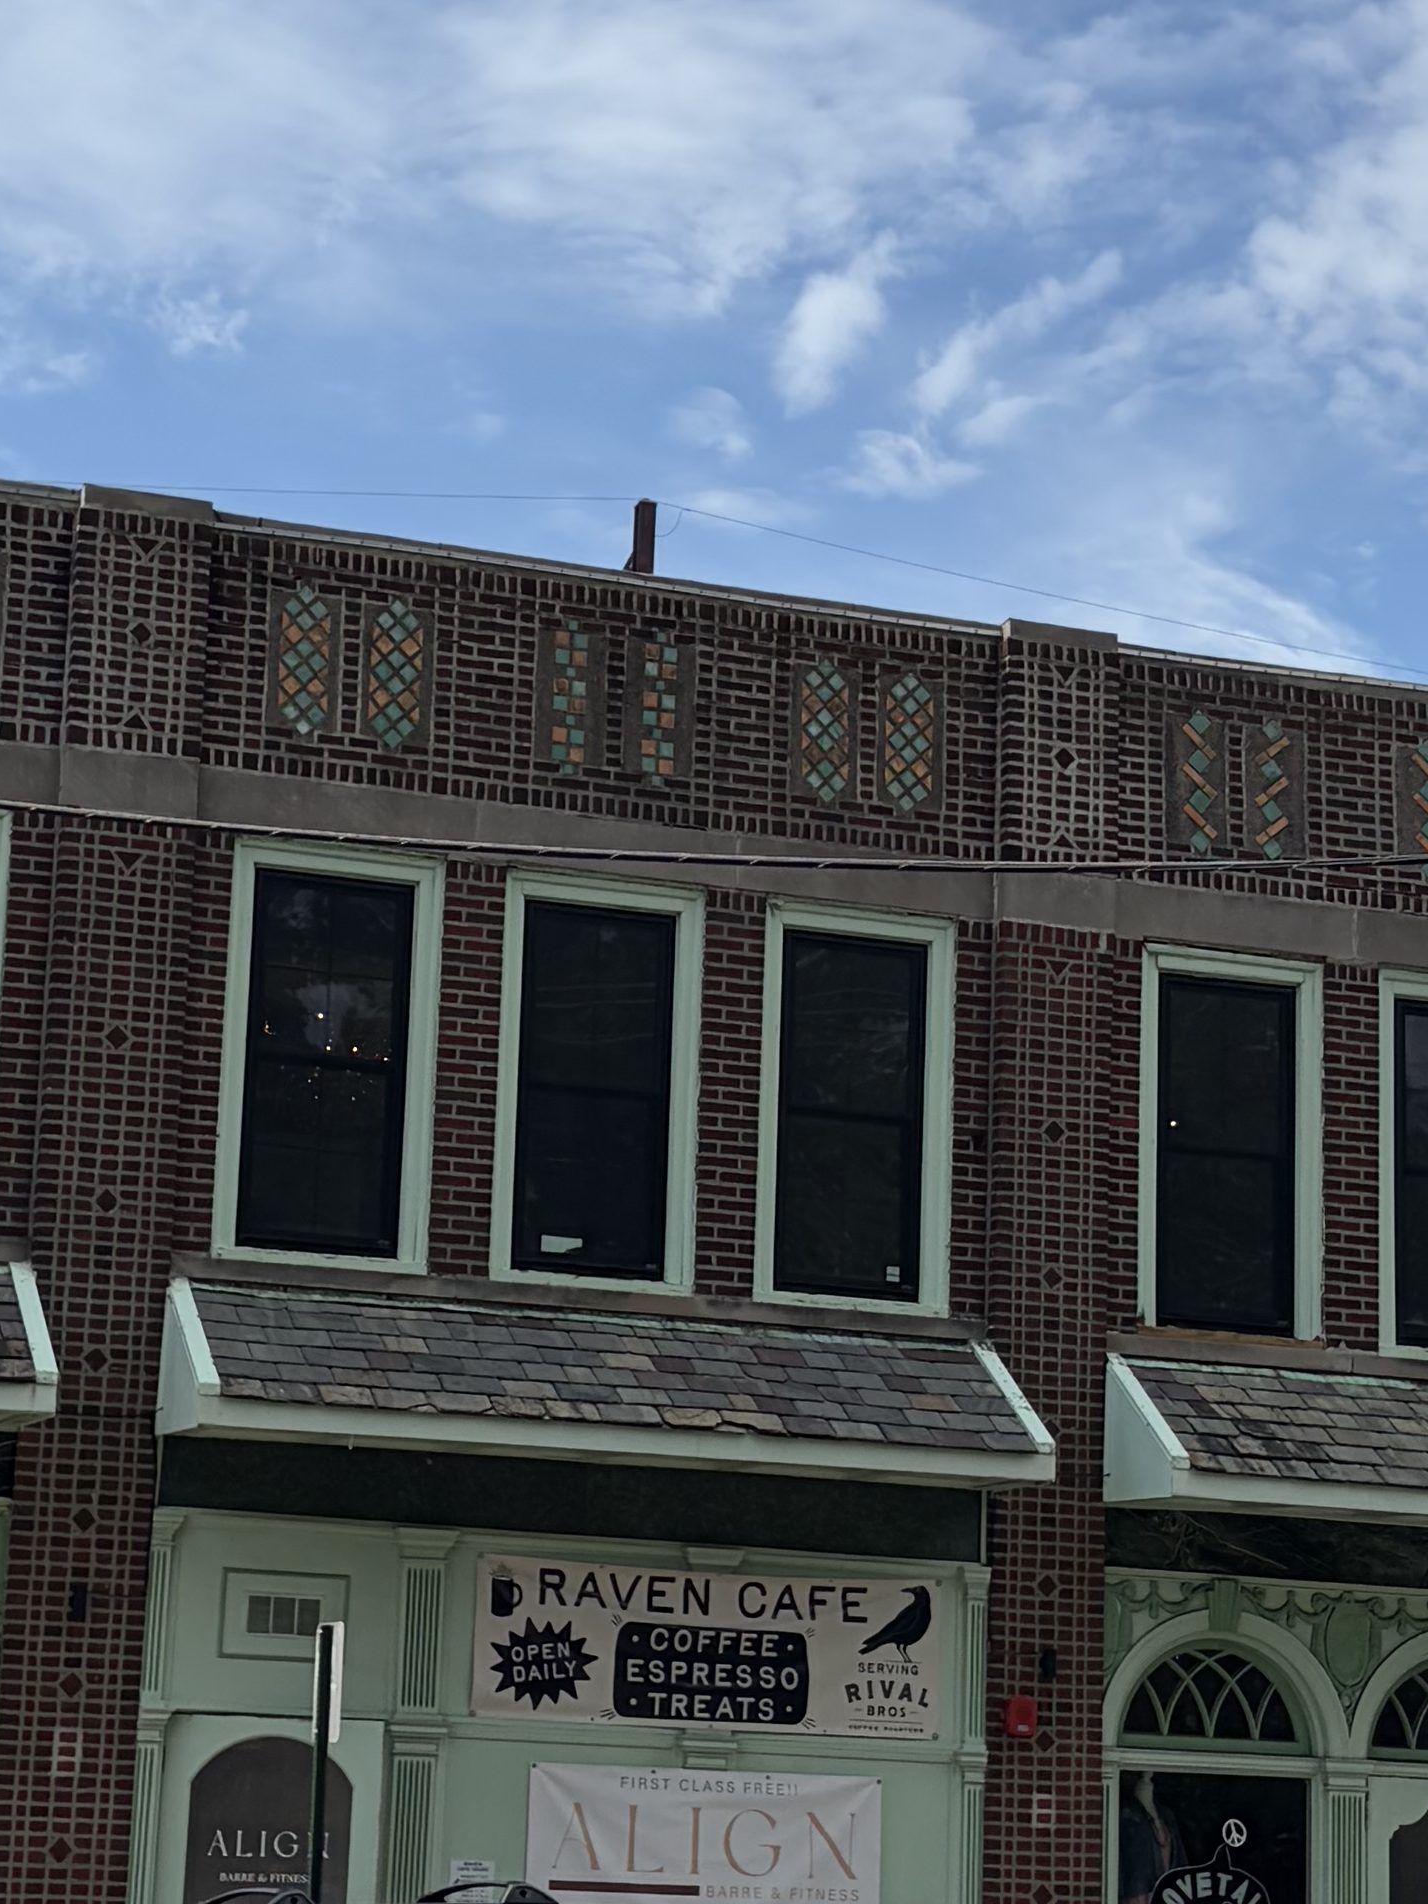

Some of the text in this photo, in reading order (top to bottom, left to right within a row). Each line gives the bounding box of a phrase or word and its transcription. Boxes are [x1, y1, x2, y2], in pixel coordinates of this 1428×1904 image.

[538, 1567, 868, 1624] RAVEN CAFE
[510, 1642, 572, 1663] OPEN
[648, 1628, 780, 1657] COFFEE
[512, 1660, 577, 1684] DAILY
[626, 1658, 800, 1691] ESPRESSO
[858, 1662, 919, 1676] SERVING
[647, 1692, 775, 1721] TREATS
[844, 1680, 929, 1708] RIVAL
[867, 1705, 906, 1718] BROS
[620, 1776, 798, 1797] FIRST CLASS FREE!!
[551, 1802, 858, 1881] ALIGN
[706, 1885, 859, 1902] BARRE & FITNESS
